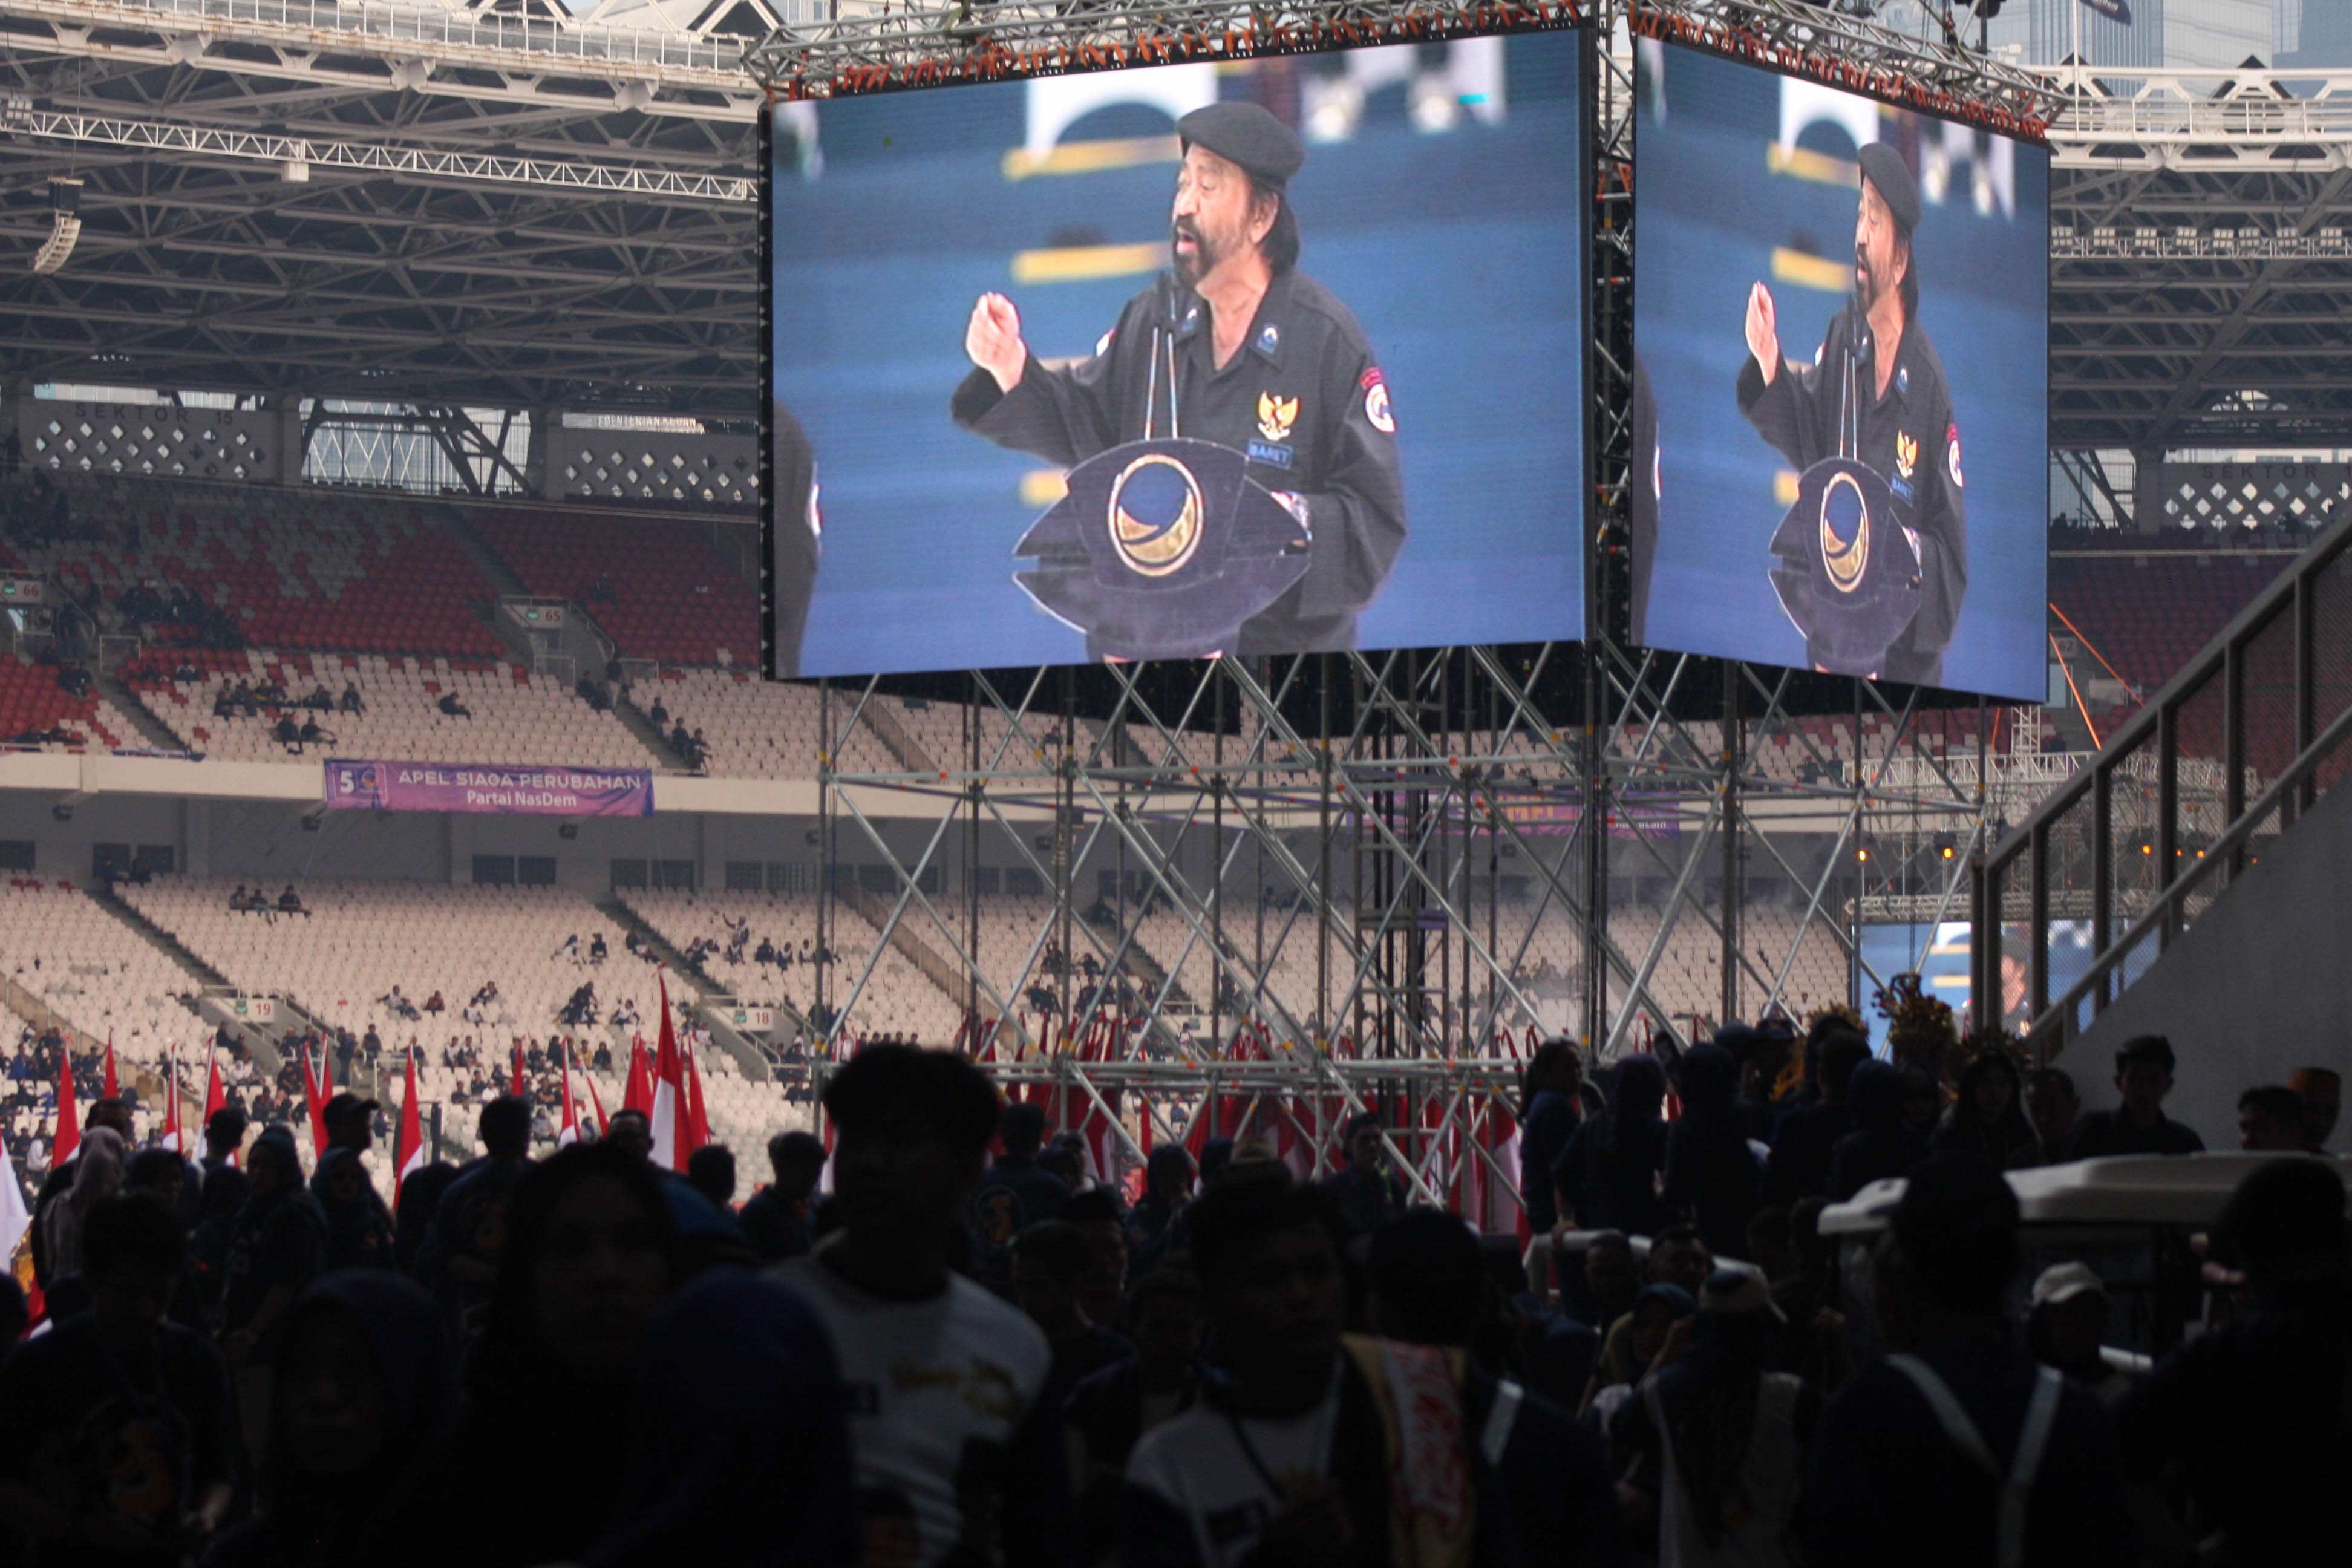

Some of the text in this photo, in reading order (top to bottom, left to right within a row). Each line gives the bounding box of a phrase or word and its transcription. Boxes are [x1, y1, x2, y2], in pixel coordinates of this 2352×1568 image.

[76, 402, 234, 425] SEKTOR 15
[2201, 464, 2317, 479] SEKTOR
[24, 583, 39, 597] 66
[546, 609, 561, 622] 65
[341, 771, 353, 793] 5
[399, 770, 449, 786] APEL
[456, 772, 513, 788] SIAGA
[520, 773, 641, 789] PERUBAHAN
[467, 791, 577, 808] Partai NasDem
[256, 1003, 271, 1016] 19
[756, 1011, 770, 1024] 18
